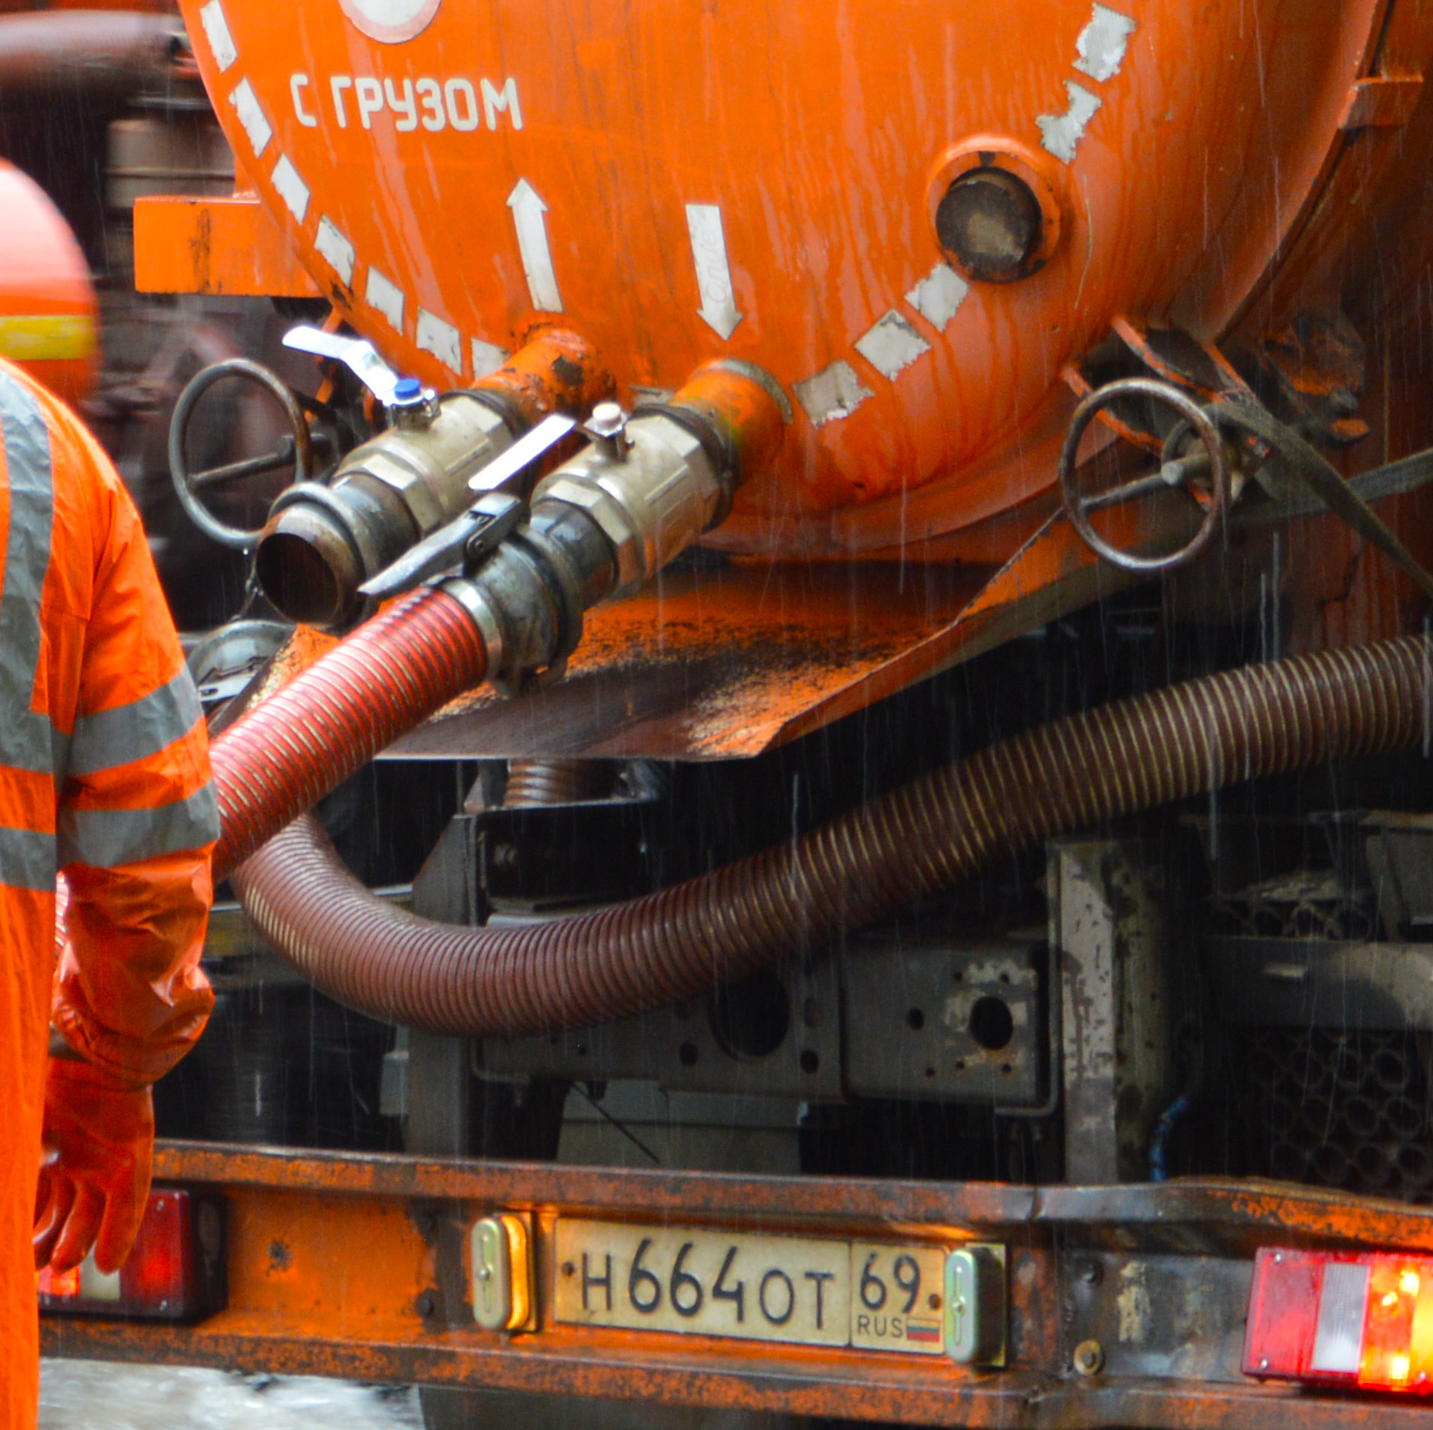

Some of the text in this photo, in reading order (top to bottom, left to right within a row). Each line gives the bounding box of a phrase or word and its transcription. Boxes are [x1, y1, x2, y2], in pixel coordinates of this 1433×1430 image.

[331, 77, 523, 132] ГРУЗОМ
[859, 1253, 922, 1314] 69
[857, 1314, 904, 1338] RUS
